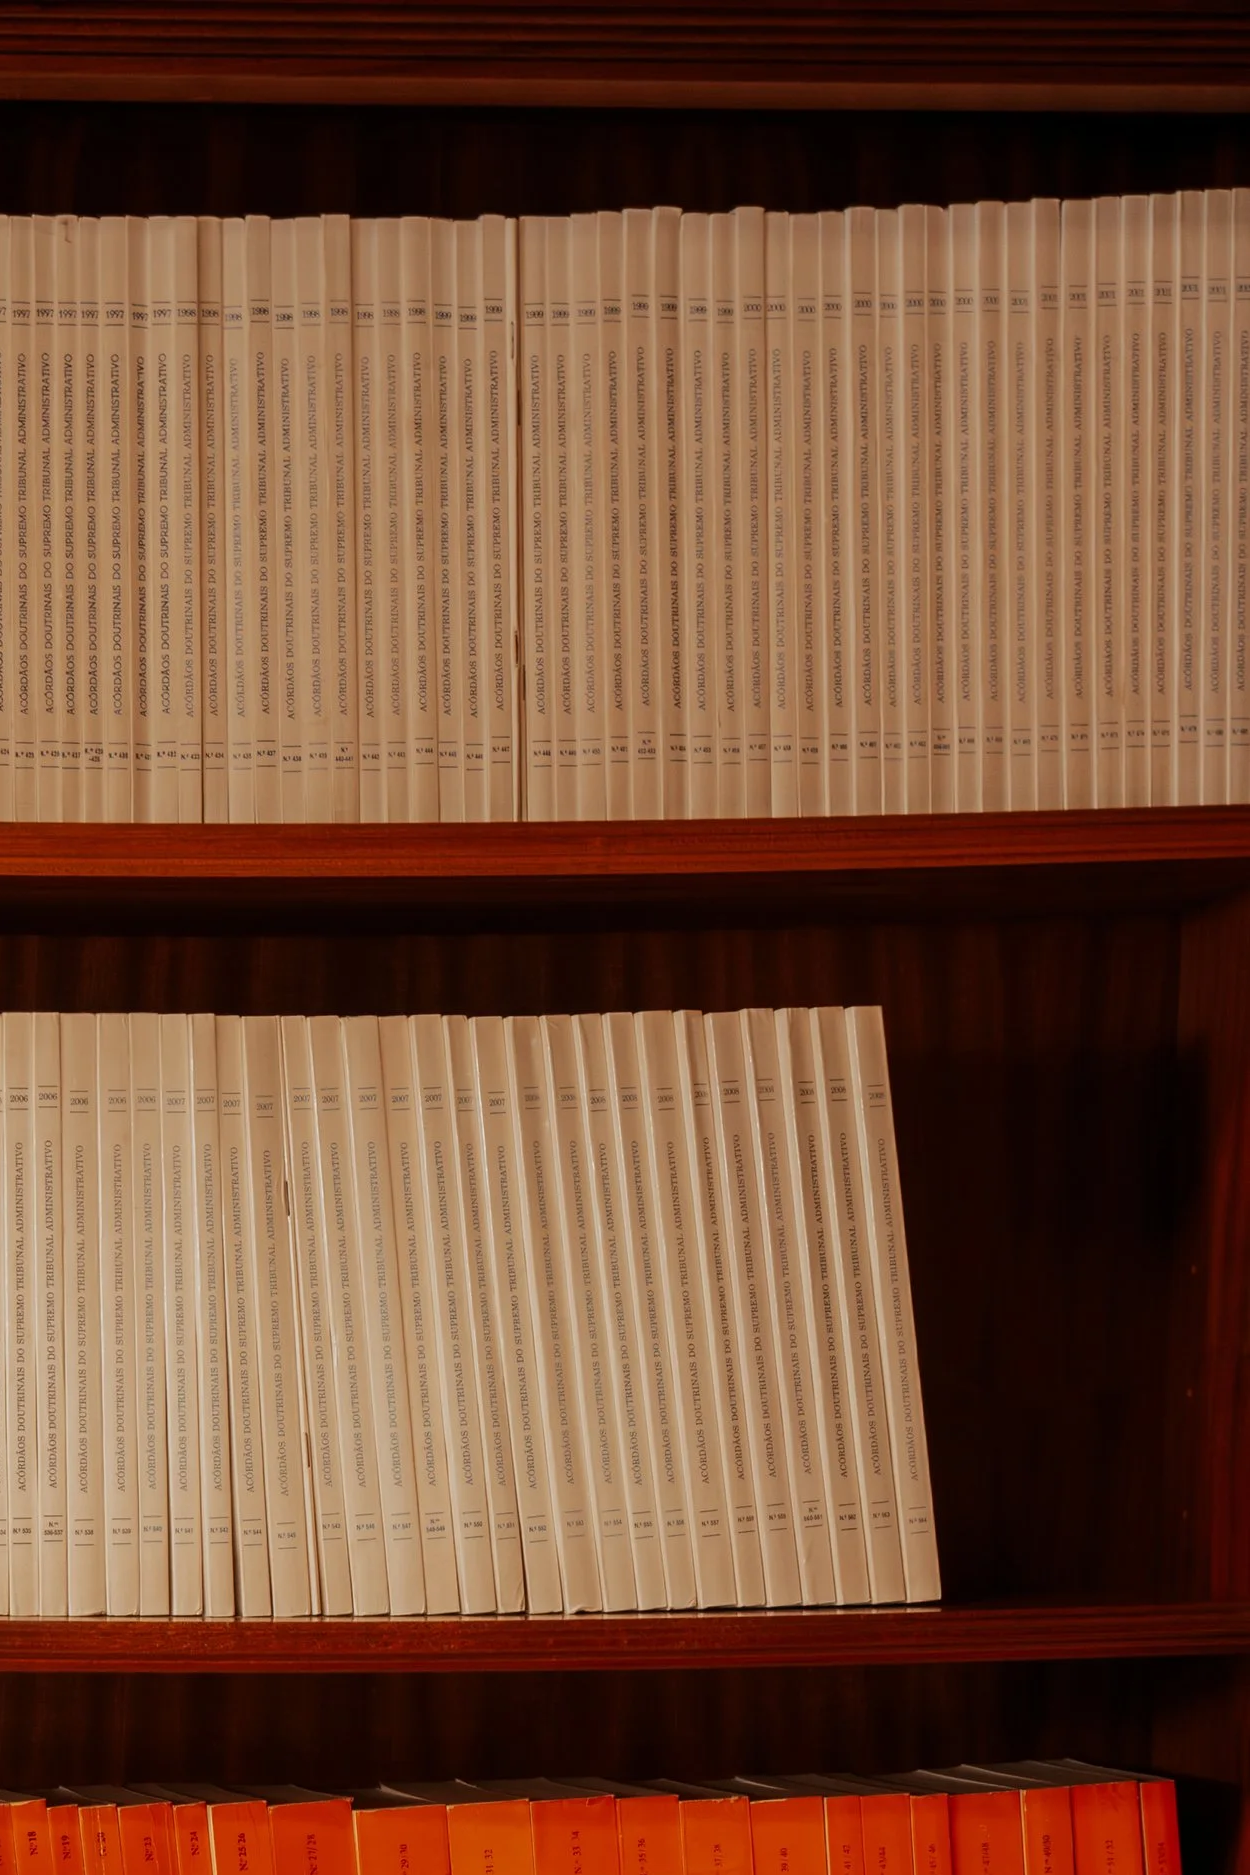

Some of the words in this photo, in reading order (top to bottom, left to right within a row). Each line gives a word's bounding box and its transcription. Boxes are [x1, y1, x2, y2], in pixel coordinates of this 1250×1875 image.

[497, 1145, 512, 1235] ADMINISTRATIVO
[505, 1238, 517, 1292] TRIBUNAL
[510, 1294, 522, 1345] SUPREMO
[514, 1347, 525, 1363] DO
[517, 1366, 531, 1431] DOUTRINAIS
[523, 1434, 537, 1489] ACÓRDÃOS
